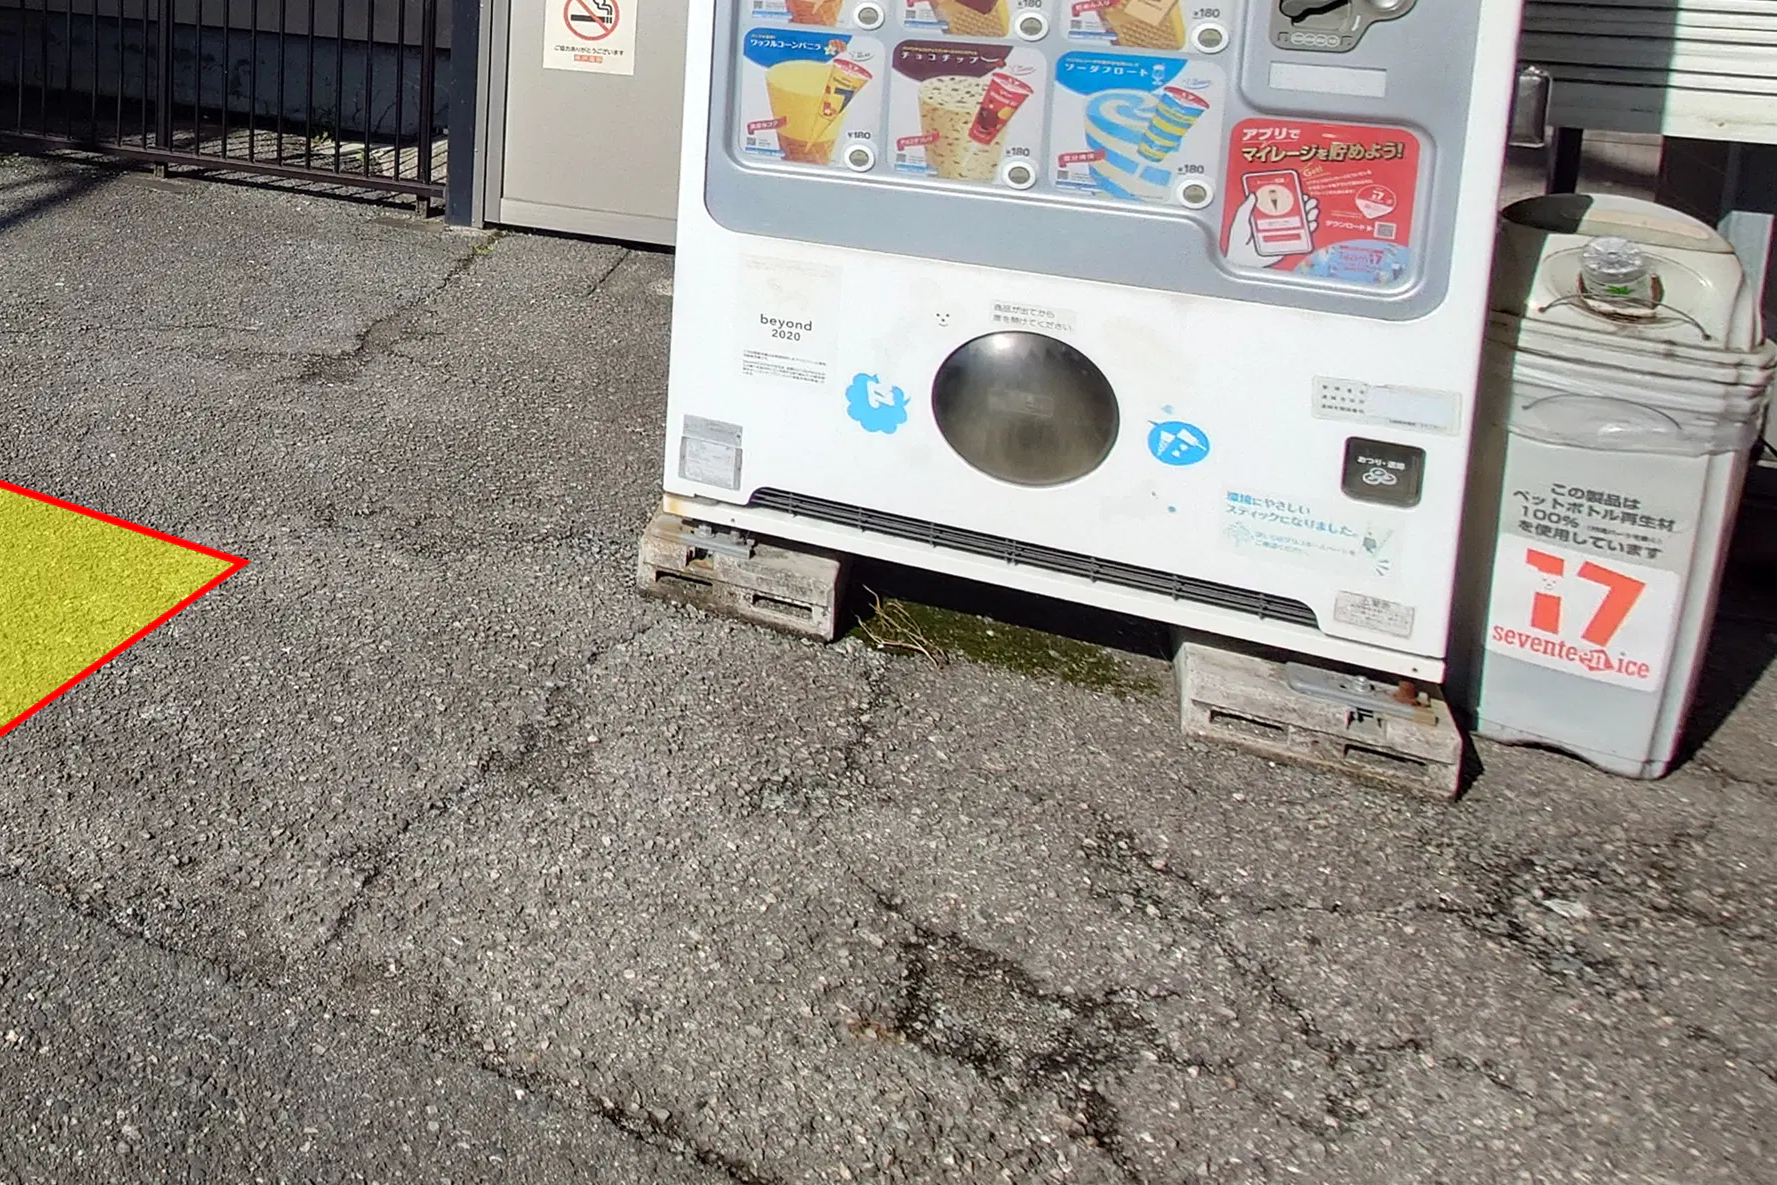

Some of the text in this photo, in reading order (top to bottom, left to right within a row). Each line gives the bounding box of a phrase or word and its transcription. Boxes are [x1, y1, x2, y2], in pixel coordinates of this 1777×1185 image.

[750, 38, 822, 51] ワッフルコーンバニラ
[901, 51, 979, 63] チョコチップ
[1065, 63, 1149, 77] ソーダフロート
[847, 131, 872, 140] ¥180
[1242, 128, 1301, 141] アプリで
[760, 313, 812, 331] beyond
[771, 329, 801, 342] 2020
[1226, 490, 1311, 515] 環境にやさしい
[1550, 482, 1641, 510] この製品は
[1513, 488, 1676, 532] ペットボトル再生材
[1521, 506, 1580, 529] 100%
[1226, 504, 1359, 537] スティックになりました。
[1518, 519, 1664, 560] を使用しています
[1492, 624, 1651, 680] seventeen ice
